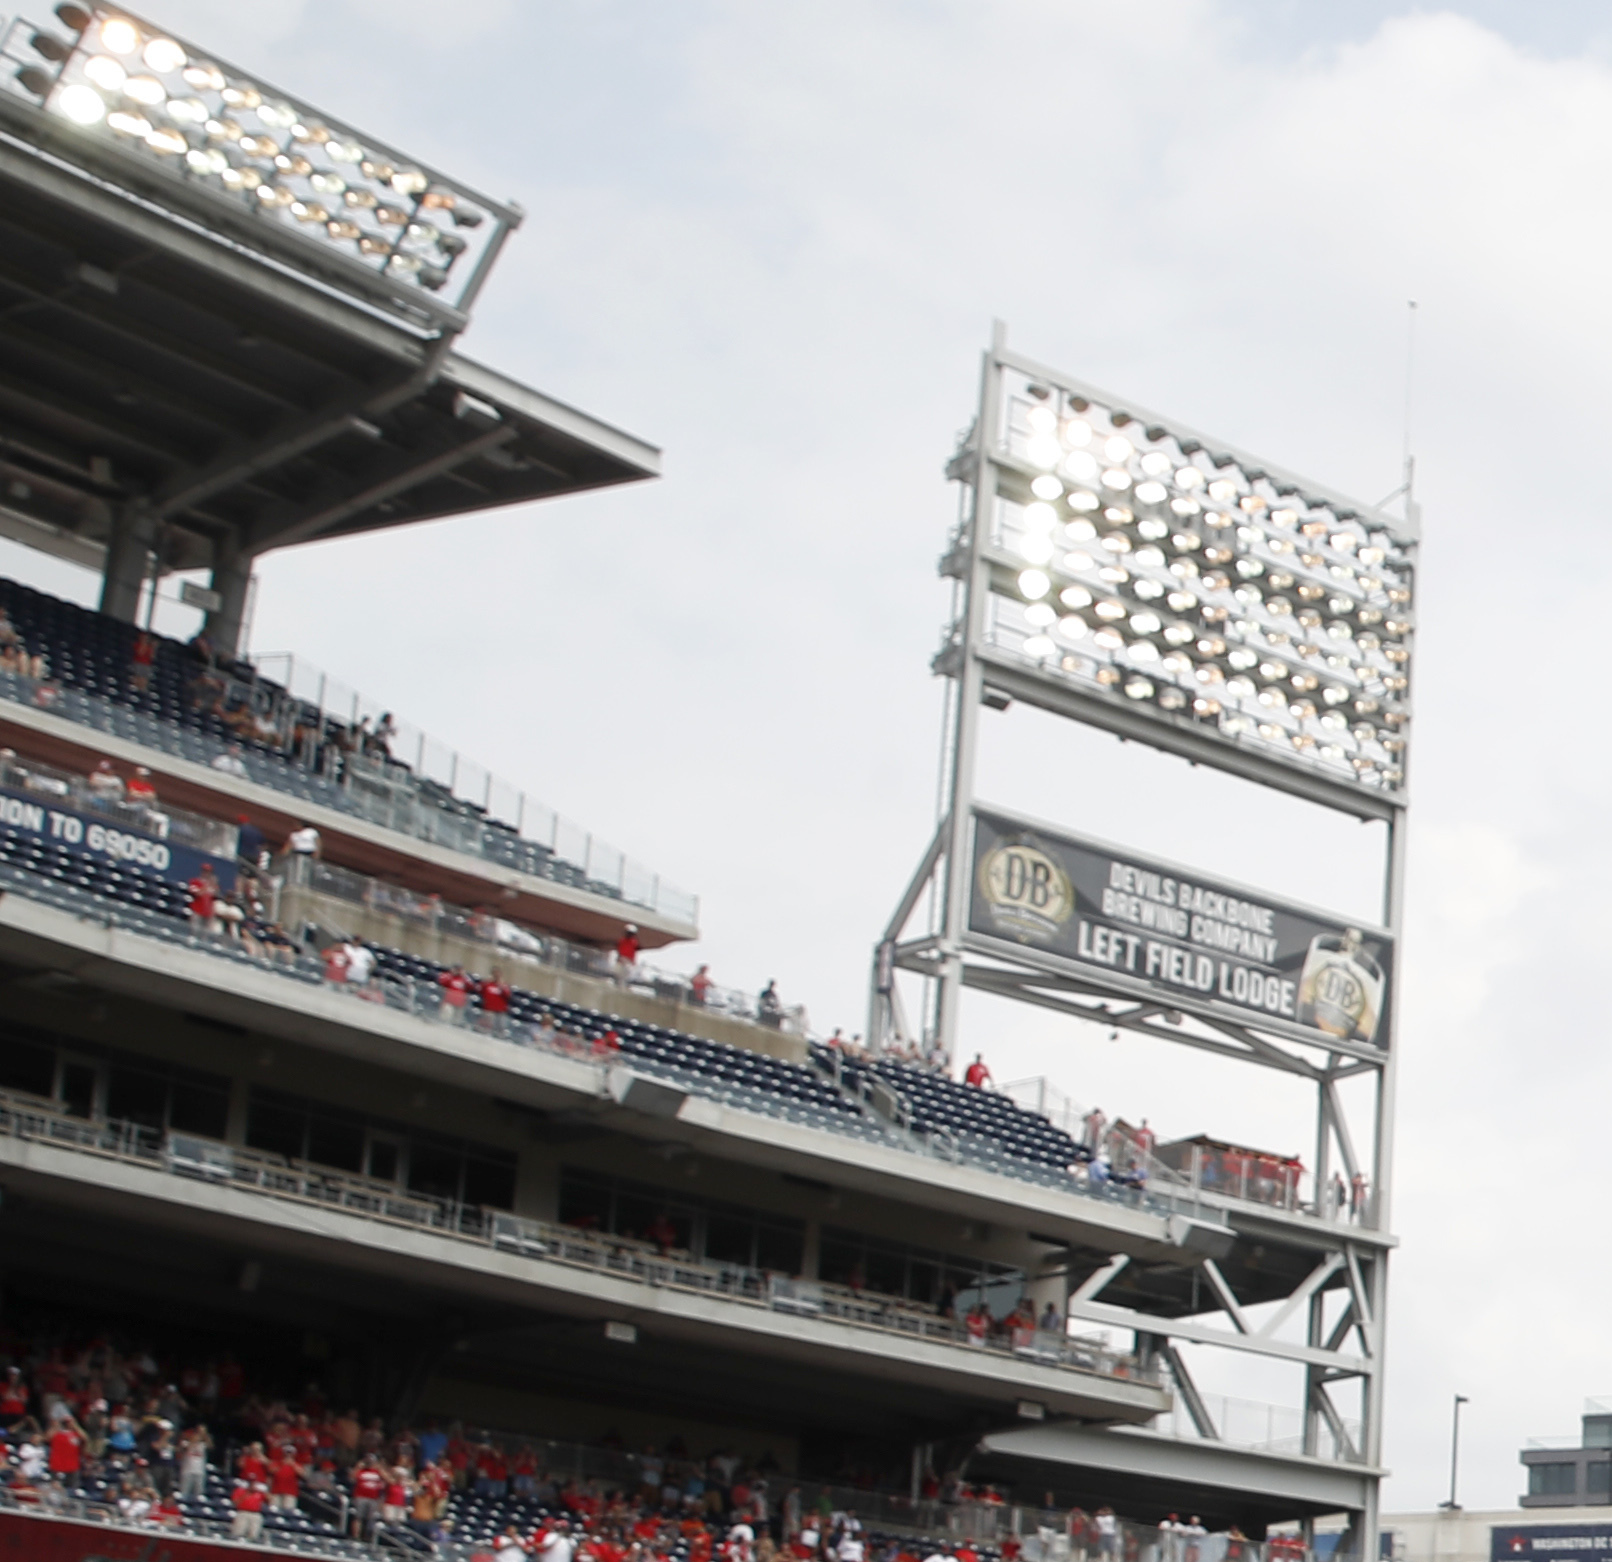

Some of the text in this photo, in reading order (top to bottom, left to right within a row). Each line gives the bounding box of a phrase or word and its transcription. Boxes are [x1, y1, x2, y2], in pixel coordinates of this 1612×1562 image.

[48, 810, 84, 844] TO
[86, 823, 171, 871] 69050
[1101, 887, 1188, 938] BREWING
[1190, 914, 1278, 964] COMPANY
[1109, 862, 1275, 936] DEVILS BACKBONE
[1077, 919, 1141, 971] LEFT
[1145, 941, 1214, 993] FIELD
[1218, 963, 1297, 1016] LODGE
[1531, 1537, 1593, 1550] WASHINGTON
[1594, 1536, 1608, 1549] DC
